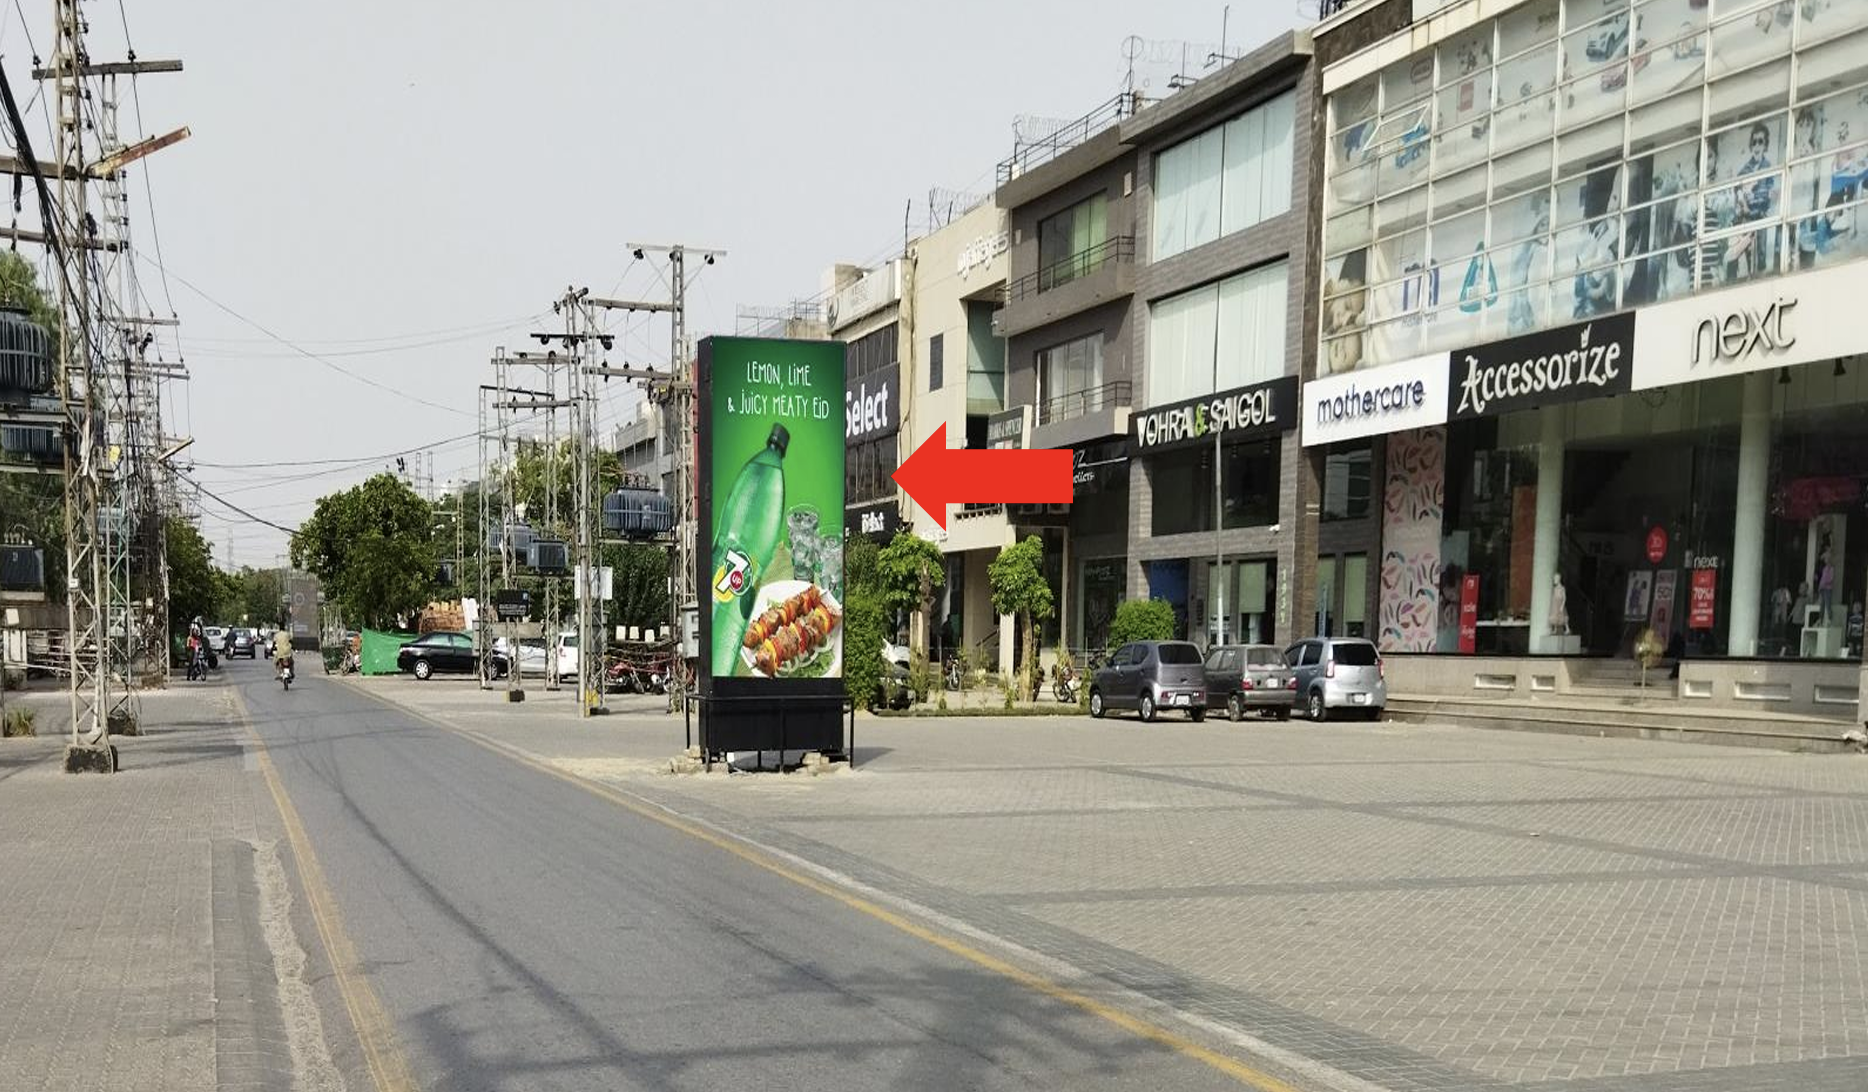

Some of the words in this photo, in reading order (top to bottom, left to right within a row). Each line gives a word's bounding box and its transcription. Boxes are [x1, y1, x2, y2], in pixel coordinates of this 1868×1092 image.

[1692, 297, 1798, 363] next
[747, 361, 784, 390] LEMON,
[1457, 324, 1621, 414] Accessorize
[727, 396, 736, 413] &
[772, 395, 808, 418] MEATY
[1137, 406, 1195, 448] VOHRA
[1194, 402, 1210, 437] &
[1208, 388, 1277, 434] SAIGOL
[1317, 379, 1426, 422] mothercare
[1693, 556, 1718, 568] next
